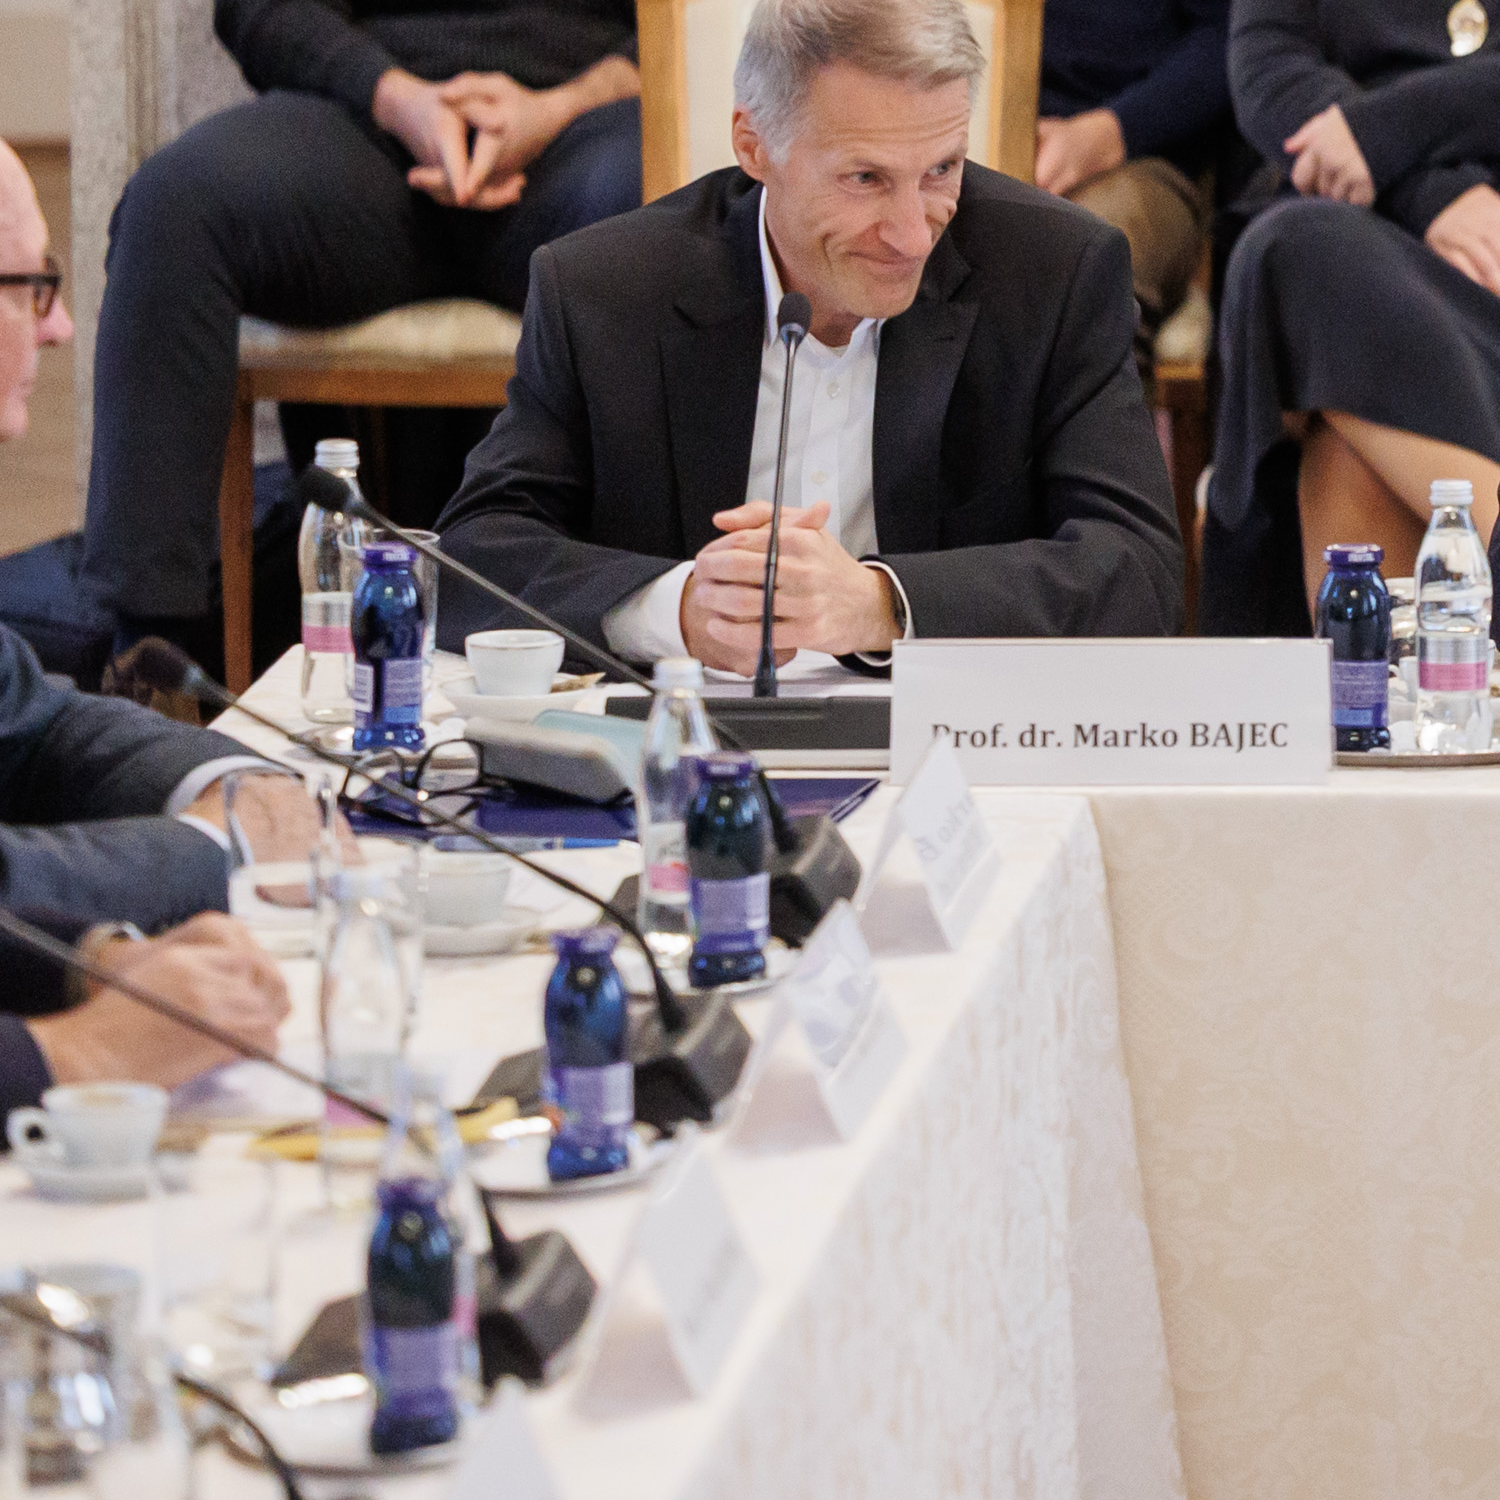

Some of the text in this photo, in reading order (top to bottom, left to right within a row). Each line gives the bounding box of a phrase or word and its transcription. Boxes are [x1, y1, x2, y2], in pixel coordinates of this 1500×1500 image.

[1018, 723, 1062, 748] dr.
[1073, 722, 1179, 748] Marko
[1190, 722, 1288, 753] BAJEC
